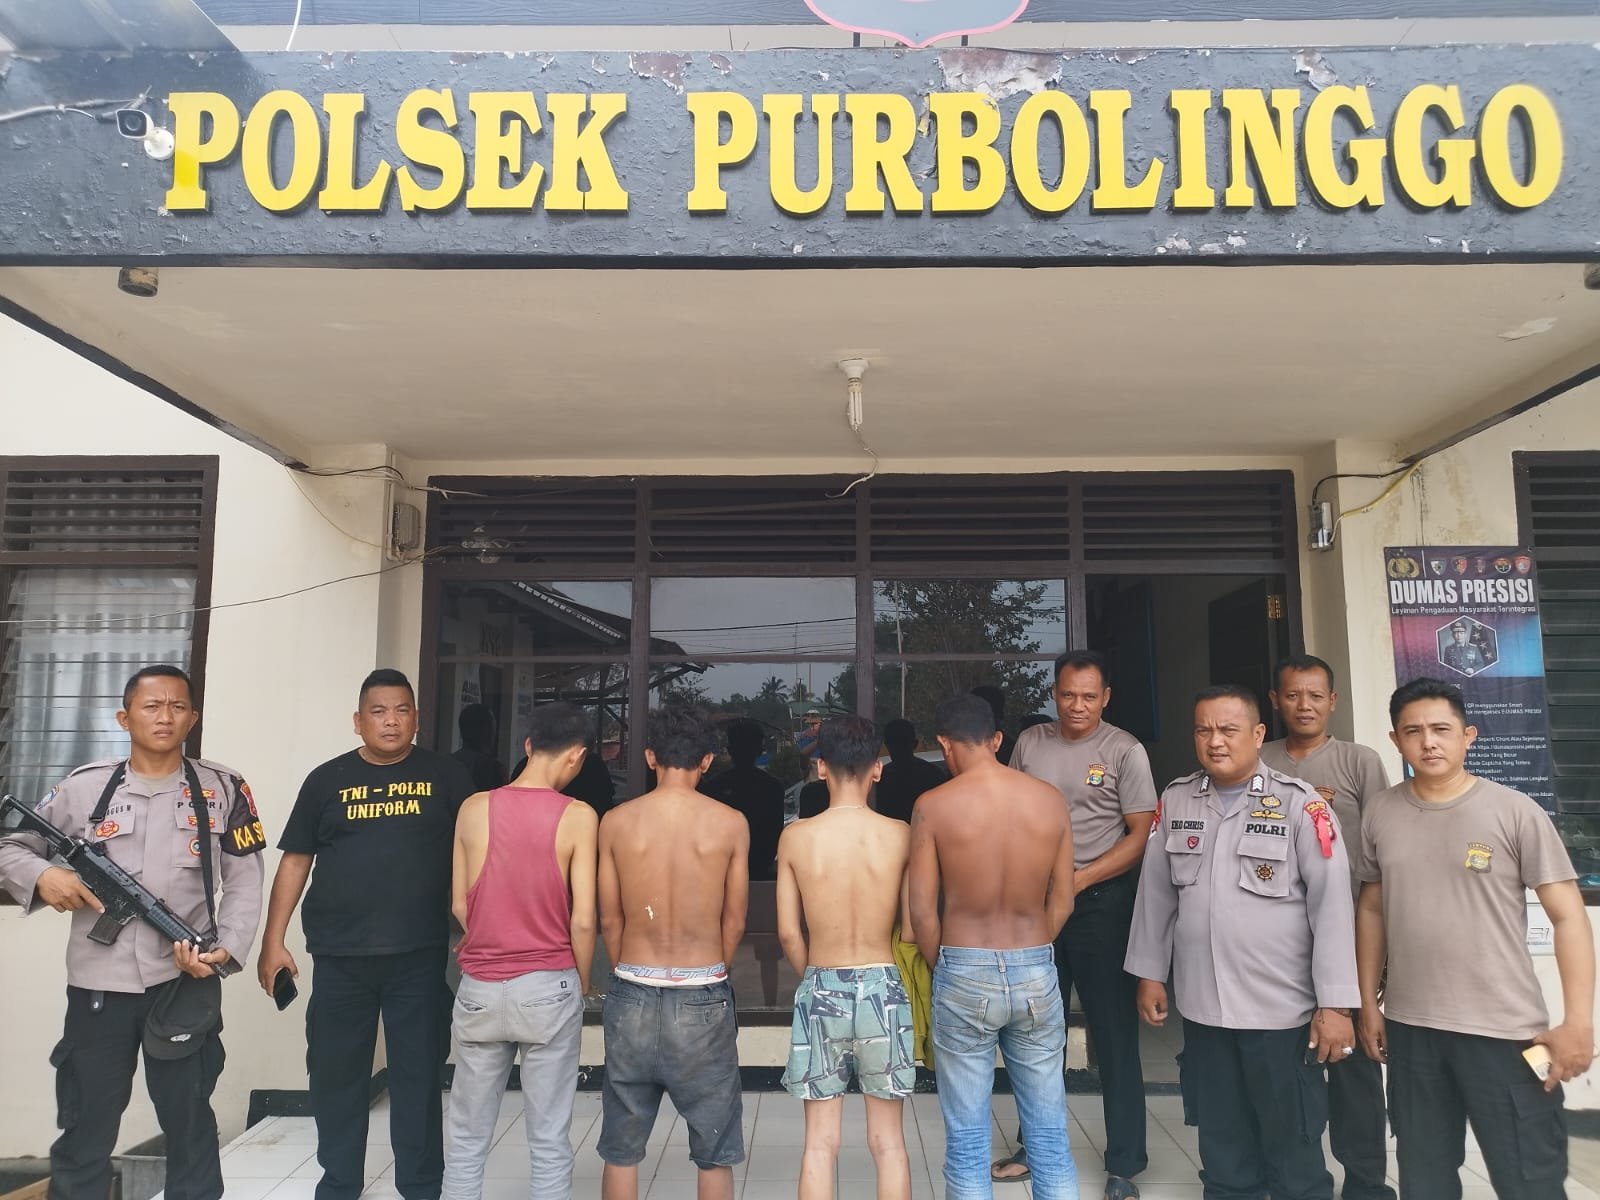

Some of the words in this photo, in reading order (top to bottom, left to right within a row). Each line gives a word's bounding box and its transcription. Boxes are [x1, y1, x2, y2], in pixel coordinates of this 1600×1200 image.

[164, 88, 629, 213] POLSEK
[686, 82, 1564, 214] PURBOLINGGO
[1390, 578, 1458, 605] DUMAS
[1461, 578, 1535, 603] PRESISI
[1391, 607, 1419, 615] Layanan
[1420, 606, 1458, 615] Pengaduan
[1458, 605, 1497, 614] Masyarakat
[339, 785, 369, 803] TNI
[387, 782, 433, 797] POLRI
[177, 801, 222, 810] PORI
[347, 799, 421, 820] UNIFORM
[1183, 820, 1204, 830] CHRIS
[1245, 823, 1287, 837] POLRI
[233, 825, 255, 850] KA
